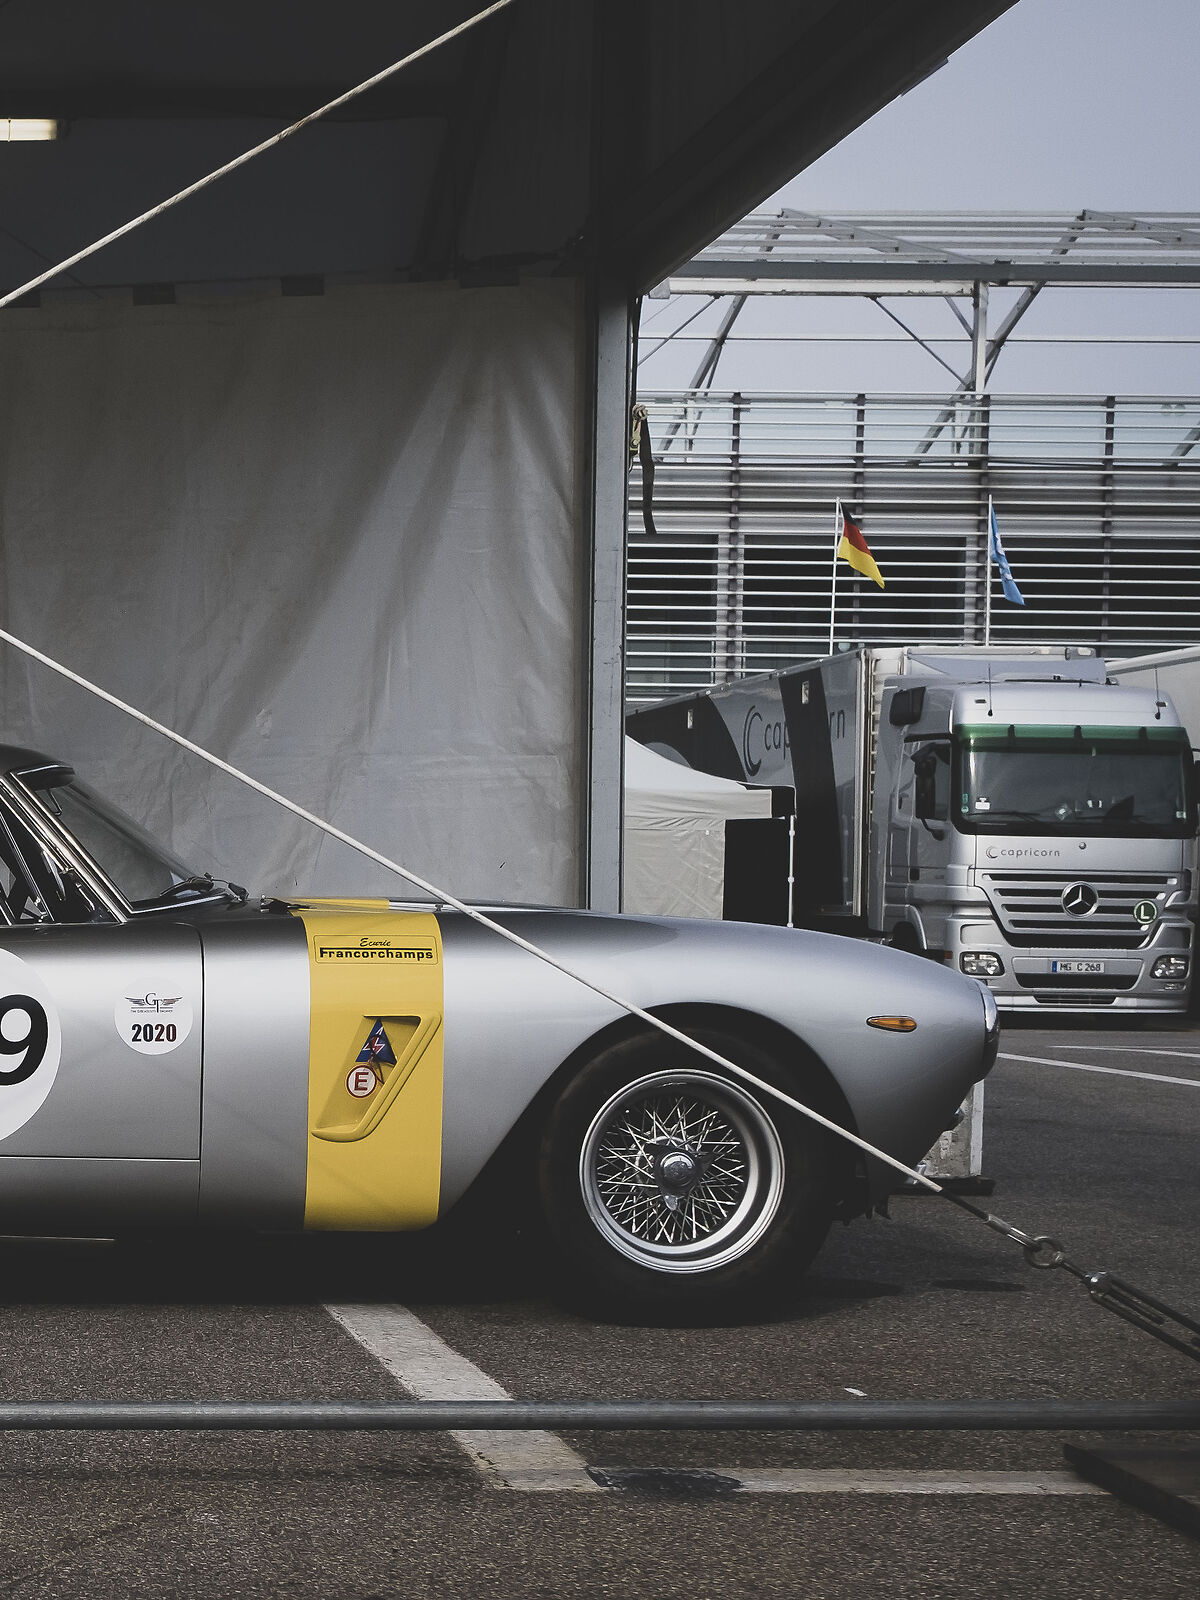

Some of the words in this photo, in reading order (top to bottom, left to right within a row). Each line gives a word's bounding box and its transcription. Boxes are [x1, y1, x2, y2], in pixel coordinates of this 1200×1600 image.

[764, 709, 846, 760] caprn
[1000, 848, 1061, 858] capricorn
[1140, 904, 1150, 920] L
[360, 937, 391, 947] Ecurie
[320, 947, 433, 961] Francorchamps
[1077, 962, 1083, 971] C
[1085, 963, 1101, 971] 268
[131, 1023, 177, 1042] 2020
[353, 1072, 369, 1091] E
